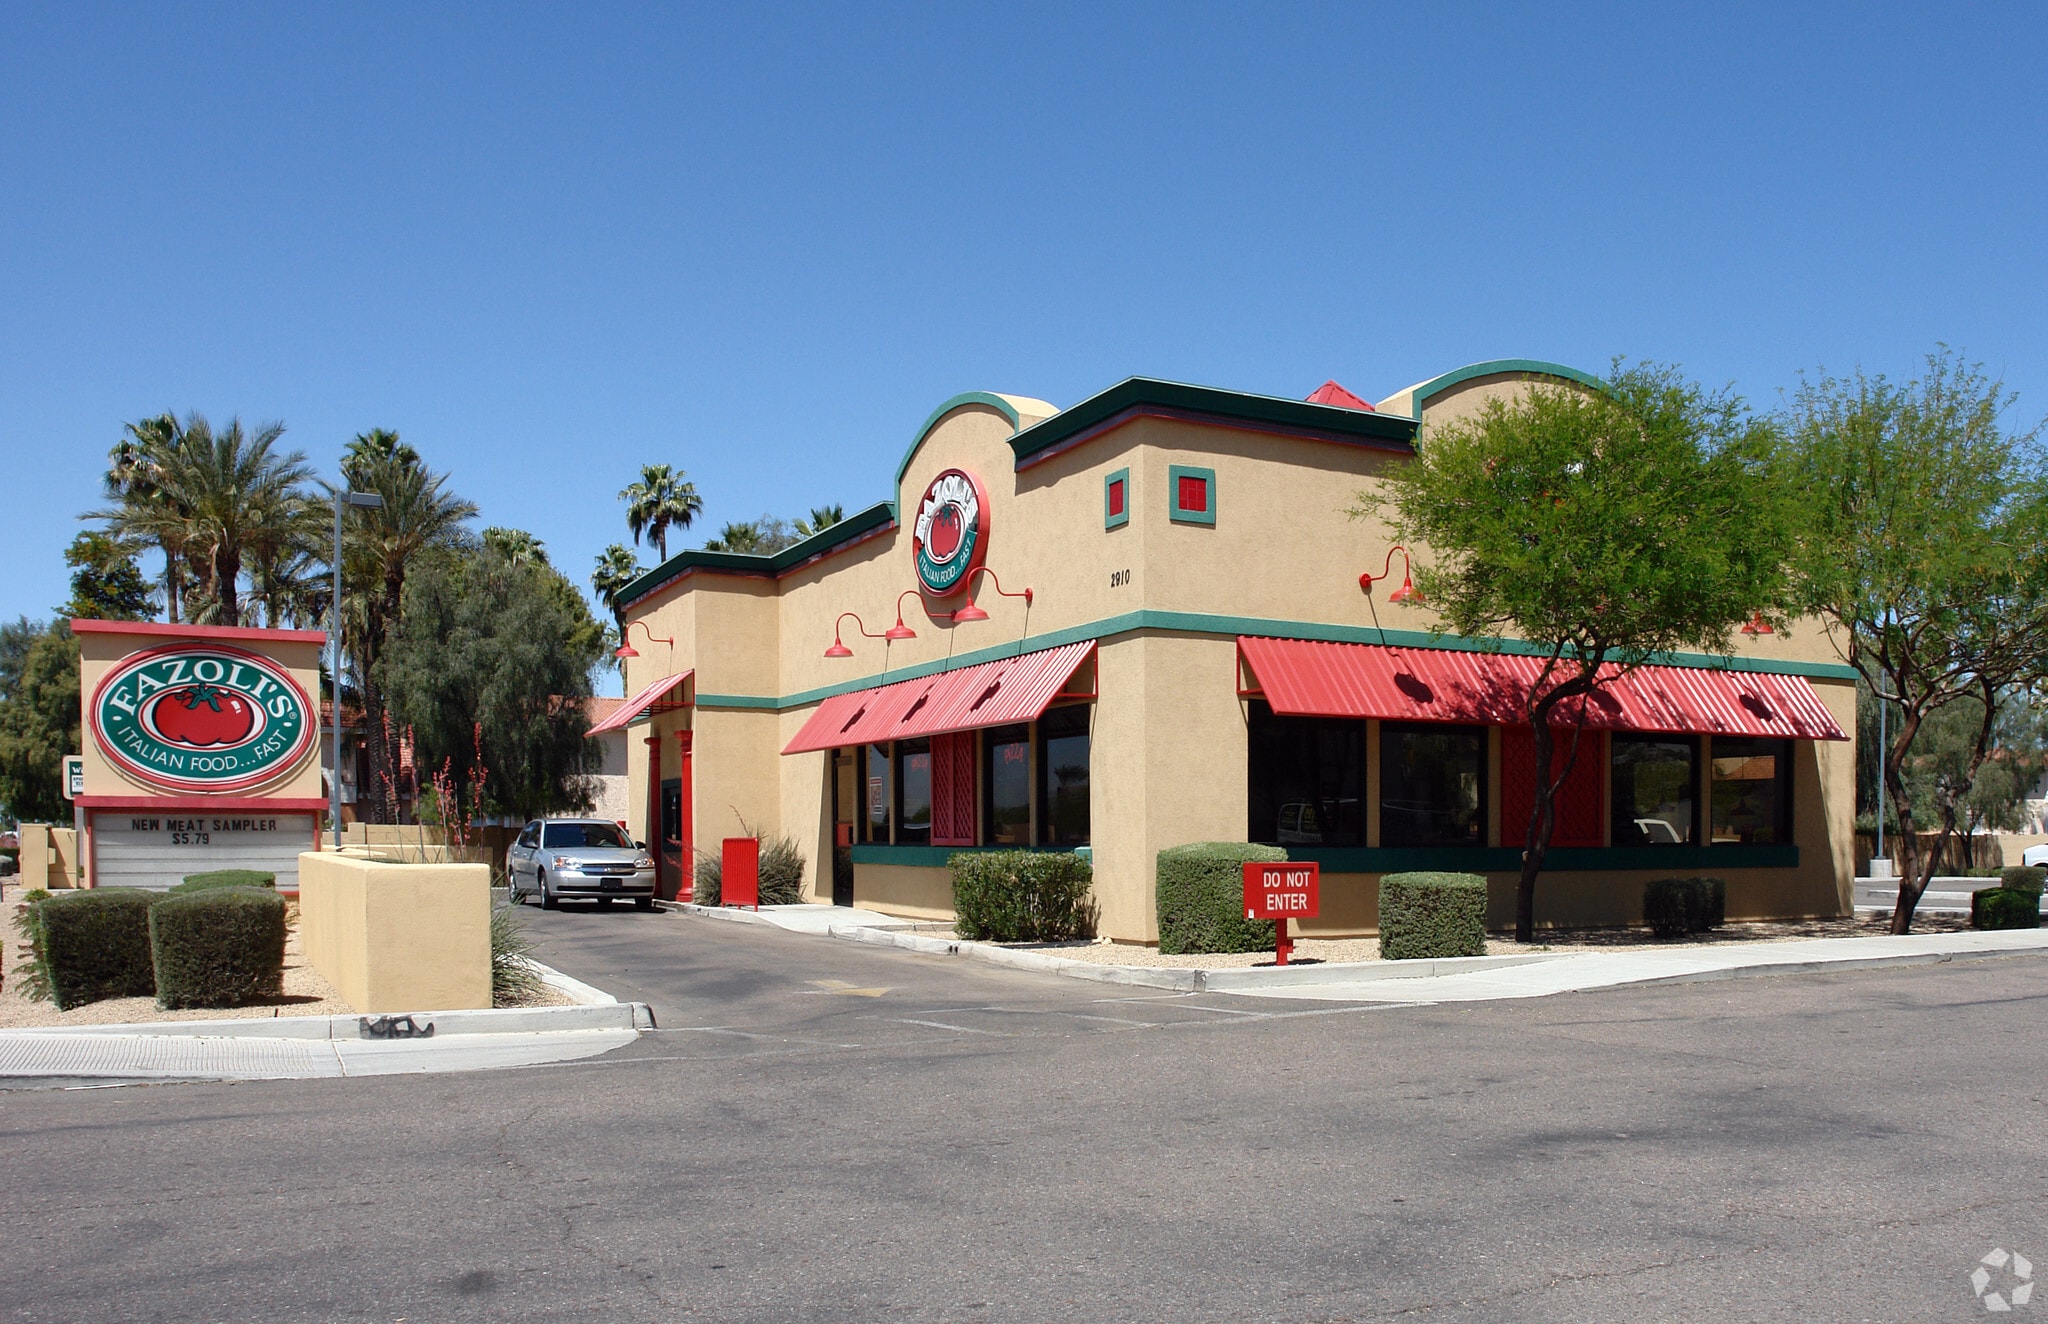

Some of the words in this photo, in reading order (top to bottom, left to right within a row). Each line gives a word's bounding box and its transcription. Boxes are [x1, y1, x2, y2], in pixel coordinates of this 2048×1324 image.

[1110, 568, 1131, 588] 2910
[109, 659, 293, 718] FAZOLI'S
[117, 726, 184, 769] ITALIAN
[132, 819, 160, 831] NEW
[166, 819, 205, 832] MEAT
[212, 819, 277, 831] SAMPLER
[1263, 871, 1281, 888] DO
[1286, 871, 1311, 887] NOT
[1266, 893, 1308, 911] ENTER
